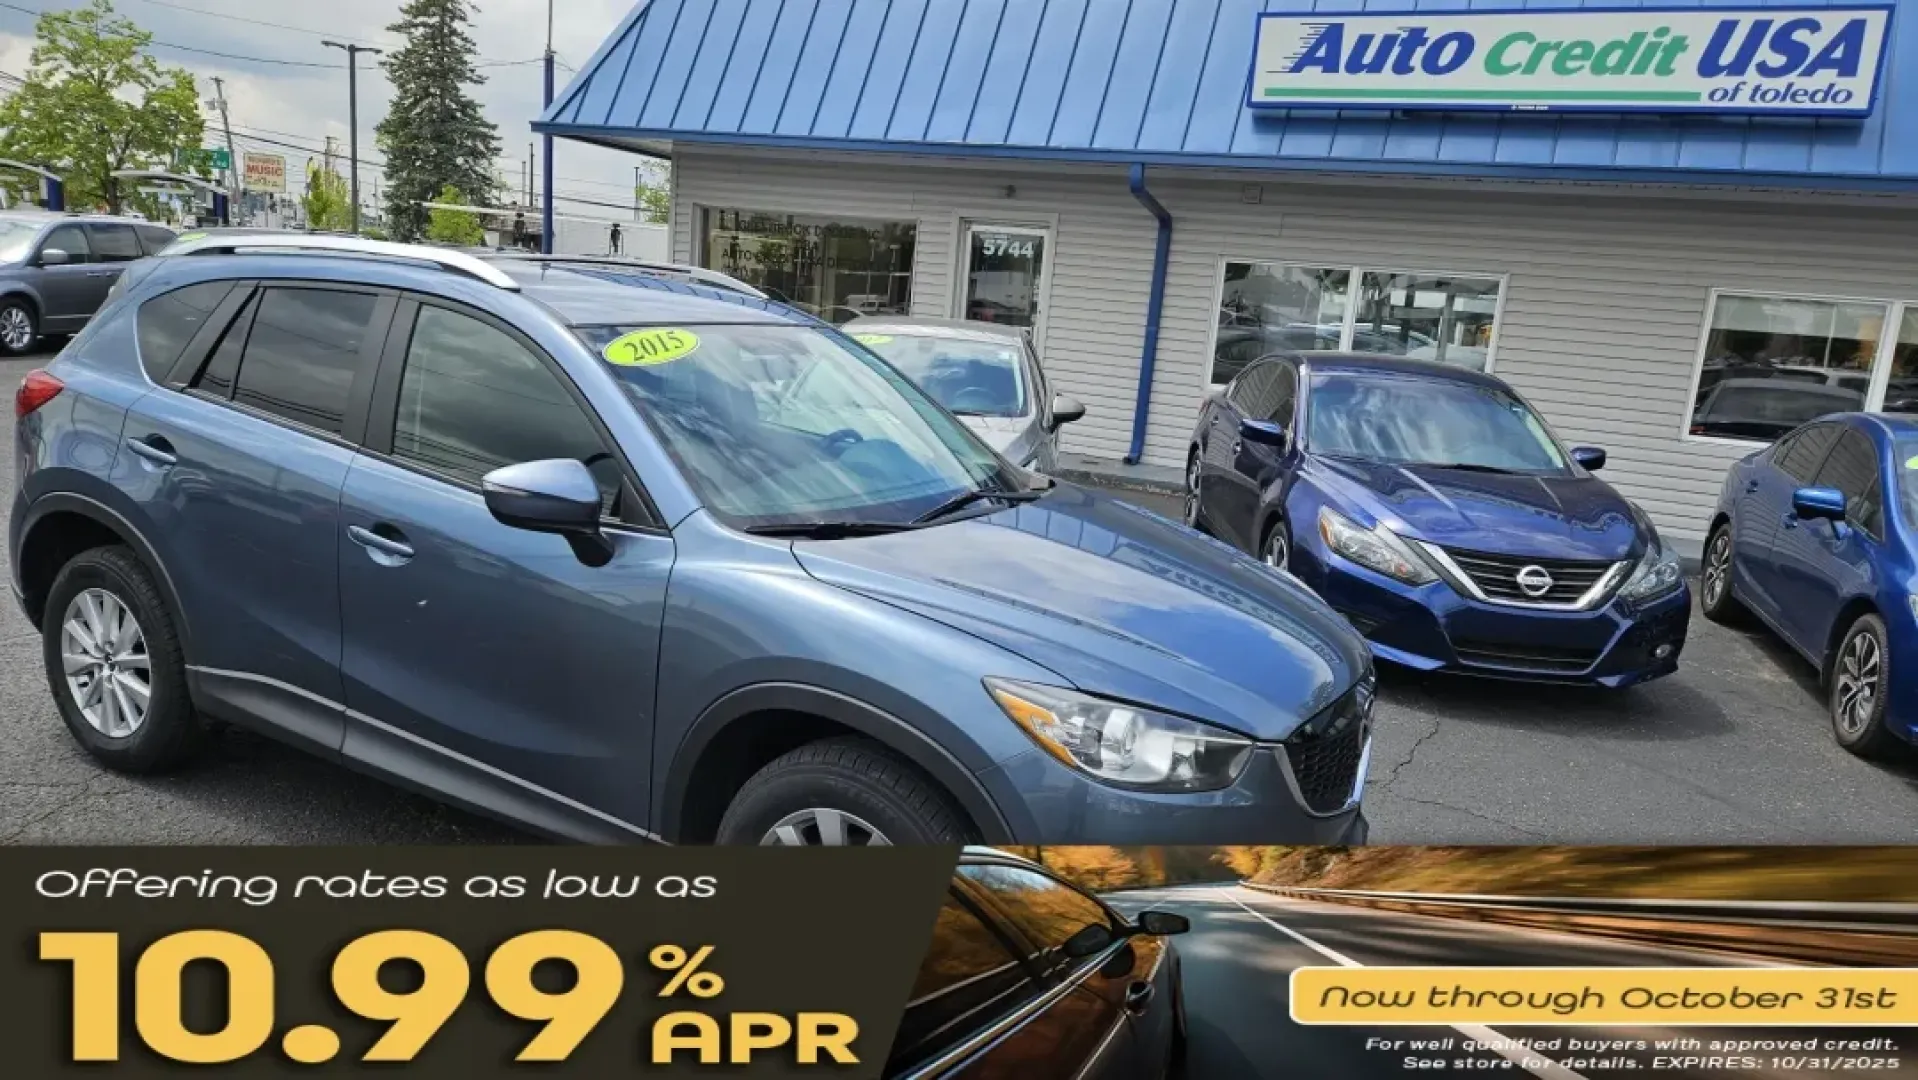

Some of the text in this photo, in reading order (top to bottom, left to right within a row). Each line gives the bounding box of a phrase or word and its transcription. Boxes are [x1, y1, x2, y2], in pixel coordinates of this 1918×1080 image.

[1286, 17, 1868, 79] Auto Credit USA
[1708, 81, 1854, 104] of toledo
[246, 163, 283, 177] MUSIC
[982, 239, 1034, 259] 5744
[624, 330, 685, 362] 2015
